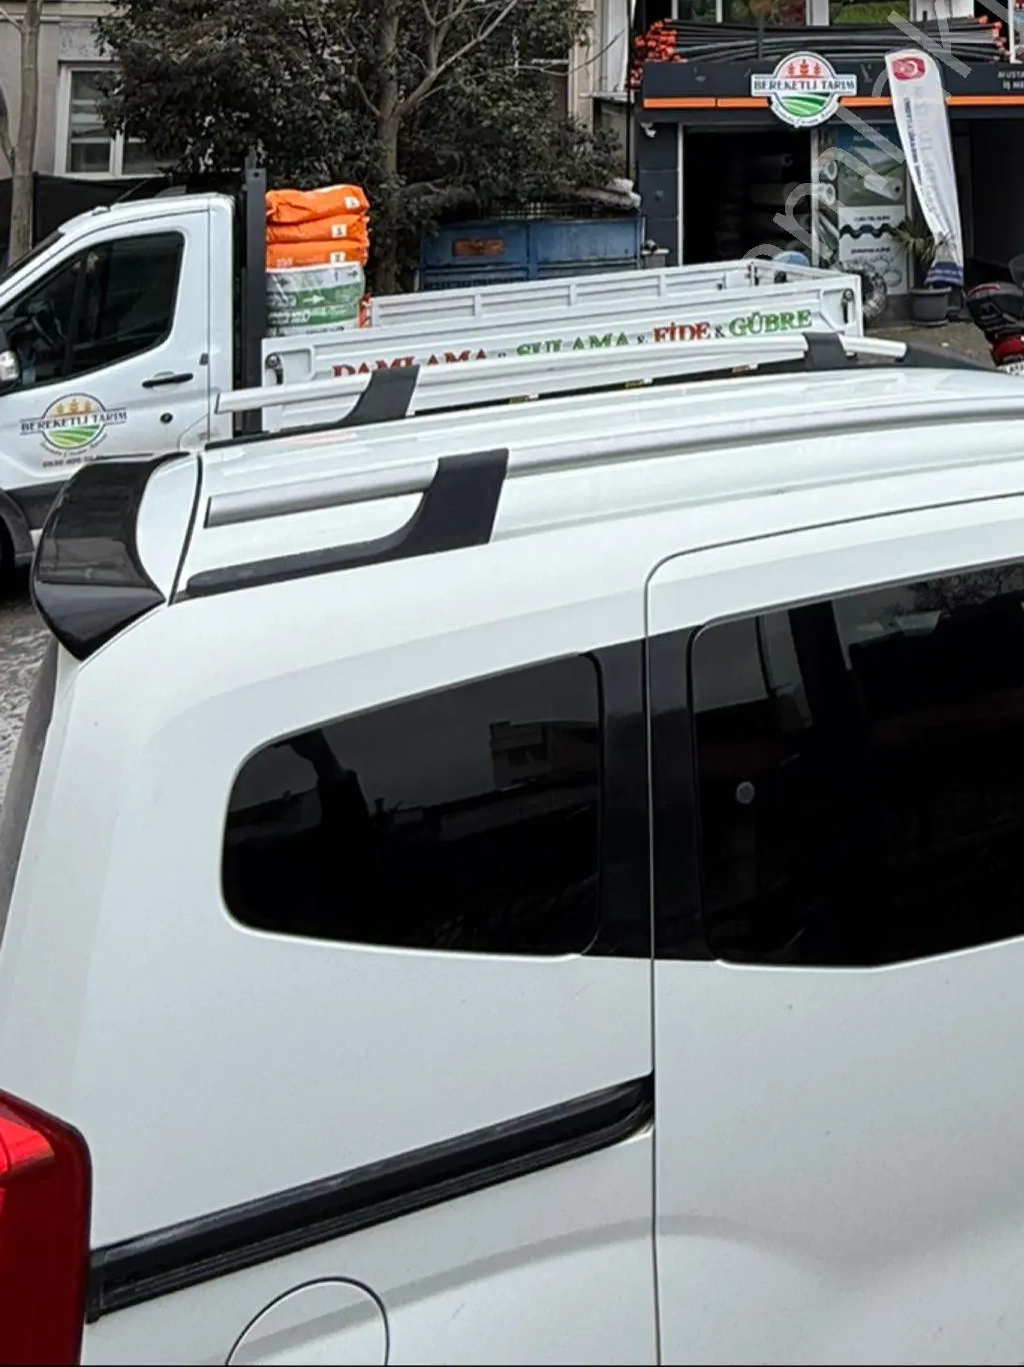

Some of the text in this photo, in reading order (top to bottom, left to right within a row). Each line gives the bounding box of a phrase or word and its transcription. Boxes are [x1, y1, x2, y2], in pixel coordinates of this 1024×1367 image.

[653, 321, 711, 344] FİDE
[715, 325, 726, 338] &
[728, 309, 812, 337] GÜBRE
